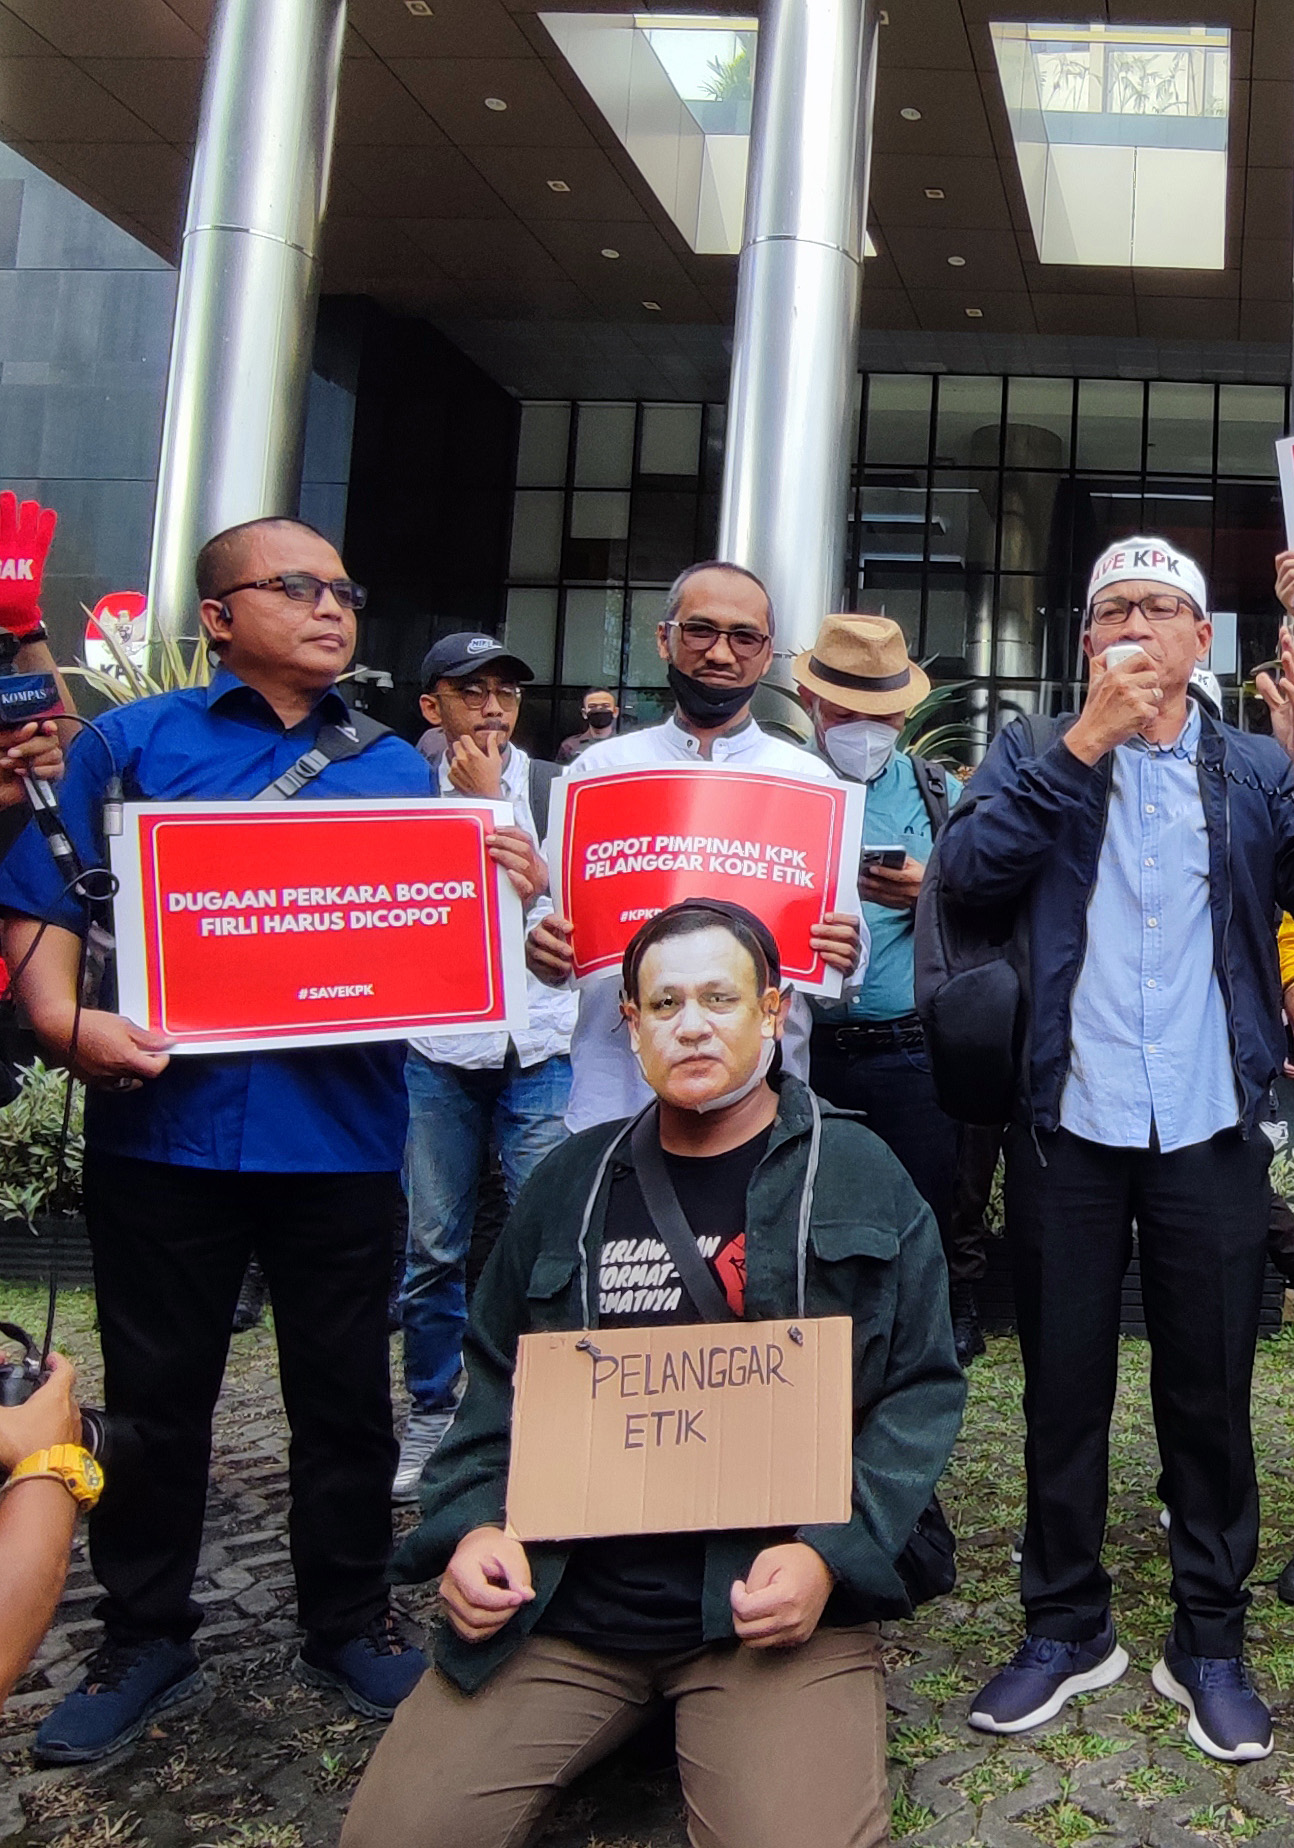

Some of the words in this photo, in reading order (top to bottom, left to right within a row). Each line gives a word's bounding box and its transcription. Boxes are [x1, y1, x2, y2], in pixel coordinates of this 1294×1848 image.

[0, 559, 34, 581] AK
[1093, 552, 1126, 582] AVE
[1133, 549, 1181, 577] KPK
[1, 688, 47, 704] KOMPAS
[585, 837, 652, 861] COPOT
[655, 836, 760, 859] PIMPINAN
[765, 847, 807, 869] KPK
[584, 854, 703, 881] PELANGGAR
[708, 857, 768, 879] KODE
[772, 867, 815, 889] ETIK
[168, 889, 277, 912] DUGAAN
[283, 884, 393, 907] PERKARA
[396, 881, 477, 901] BOCOR
[201, 917, 258, 937] FIRLI
[263, 911, 346, 933] HARUS
[350, 906, 452, 929] DICOPOT
[298, 983, 375, 1000] #SAVEKPK
[592, 1344, 795, 1400] PELANGGAR
[624, 1409, 707, 1450] ETIK
